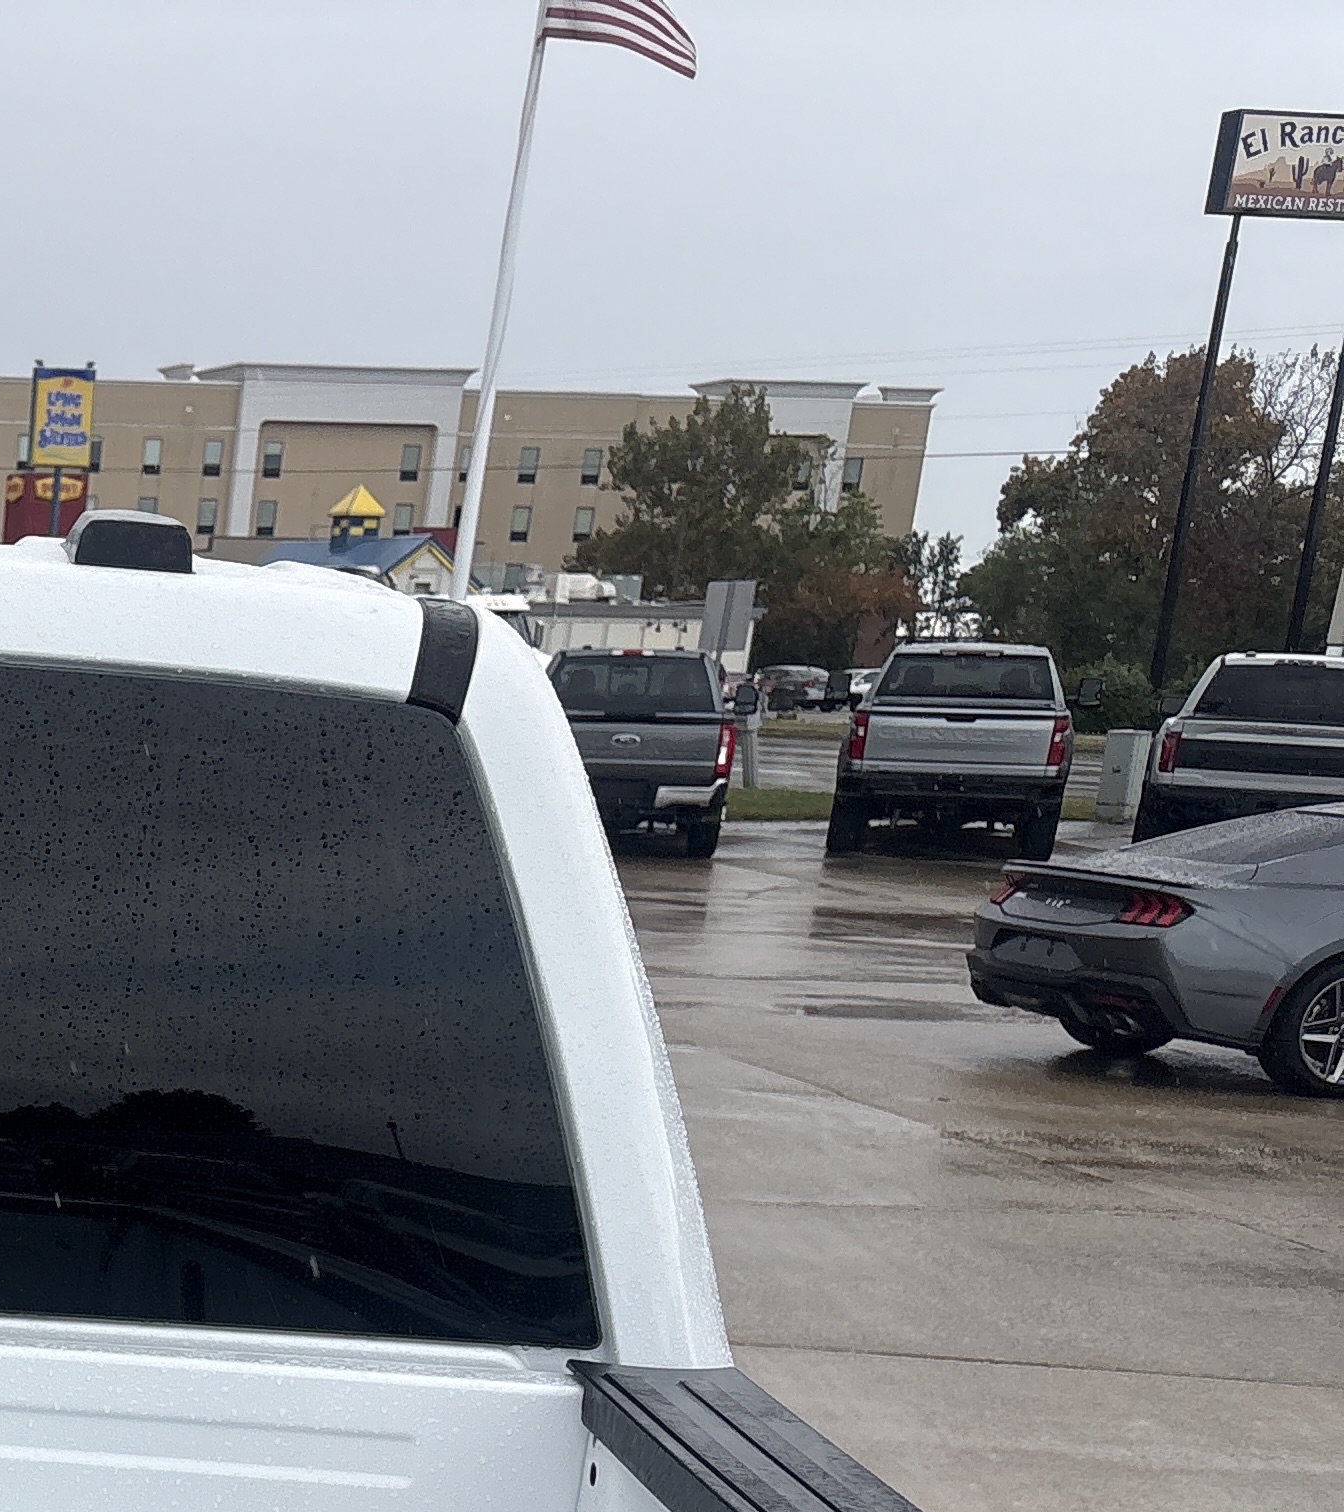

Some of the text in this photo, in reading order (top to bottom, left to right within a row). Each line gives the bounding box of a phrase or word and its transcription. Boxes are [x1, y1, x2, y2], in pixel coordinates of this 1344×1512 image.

[1241, 121, 1344, 159] El Ranc
[1233, 193, 1344, 212] MEXICAN REST
